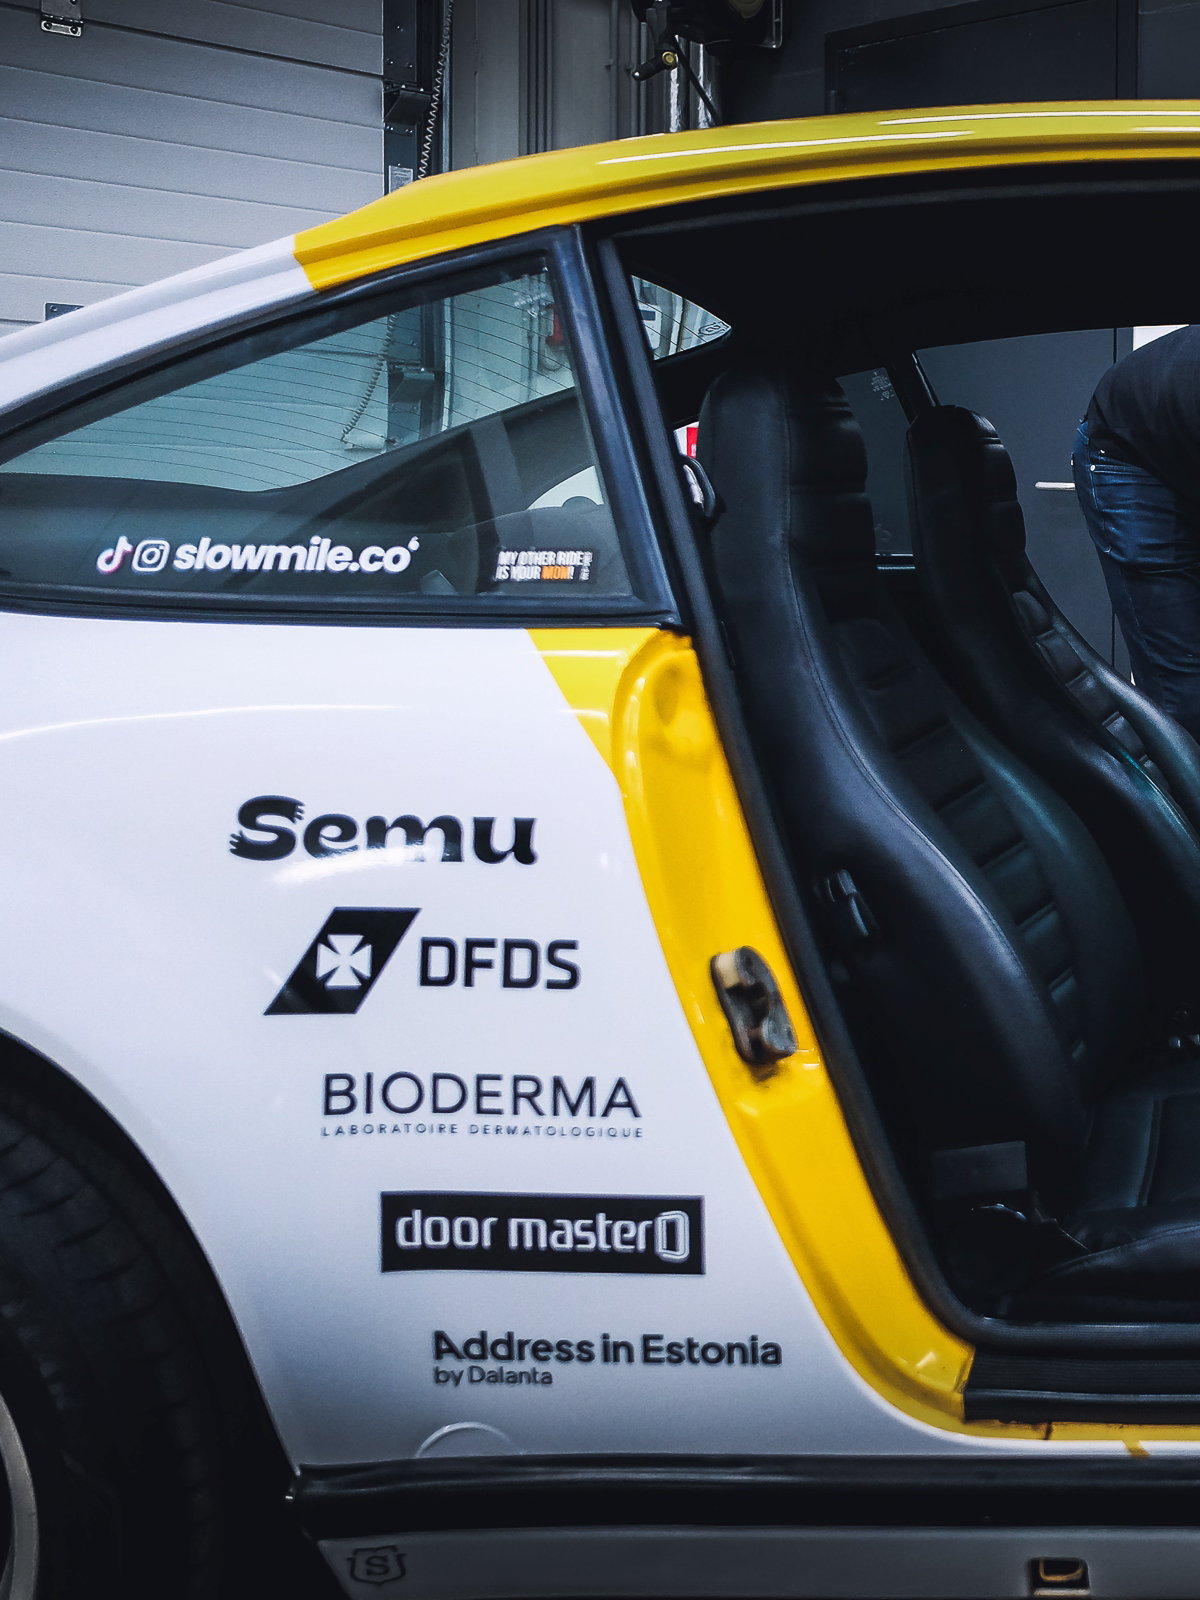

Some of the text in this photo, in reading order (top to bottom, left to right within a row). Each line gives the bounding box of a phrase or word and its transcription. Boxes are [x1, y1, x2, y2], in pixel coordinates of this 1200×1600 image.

[495, 566, 510, 579] IS
[510, 566, 541, 580] YOUR
[498, 551, 584, 565] MY OTHER RIDE
[229, 794, 538, 865] Semu
[419, 936, 582, 990] DFDS
[322, 1071, 643, 1119] BIODERMA
[321, 1123, 644, 1138] LABORATOIRE DERMATOLOGIQUE
[395, 1208, 498, 1250] door
[432, 1330, 783, 1366] Address in Estonia
[433, 1365, 553, 1387] by Dalanta
